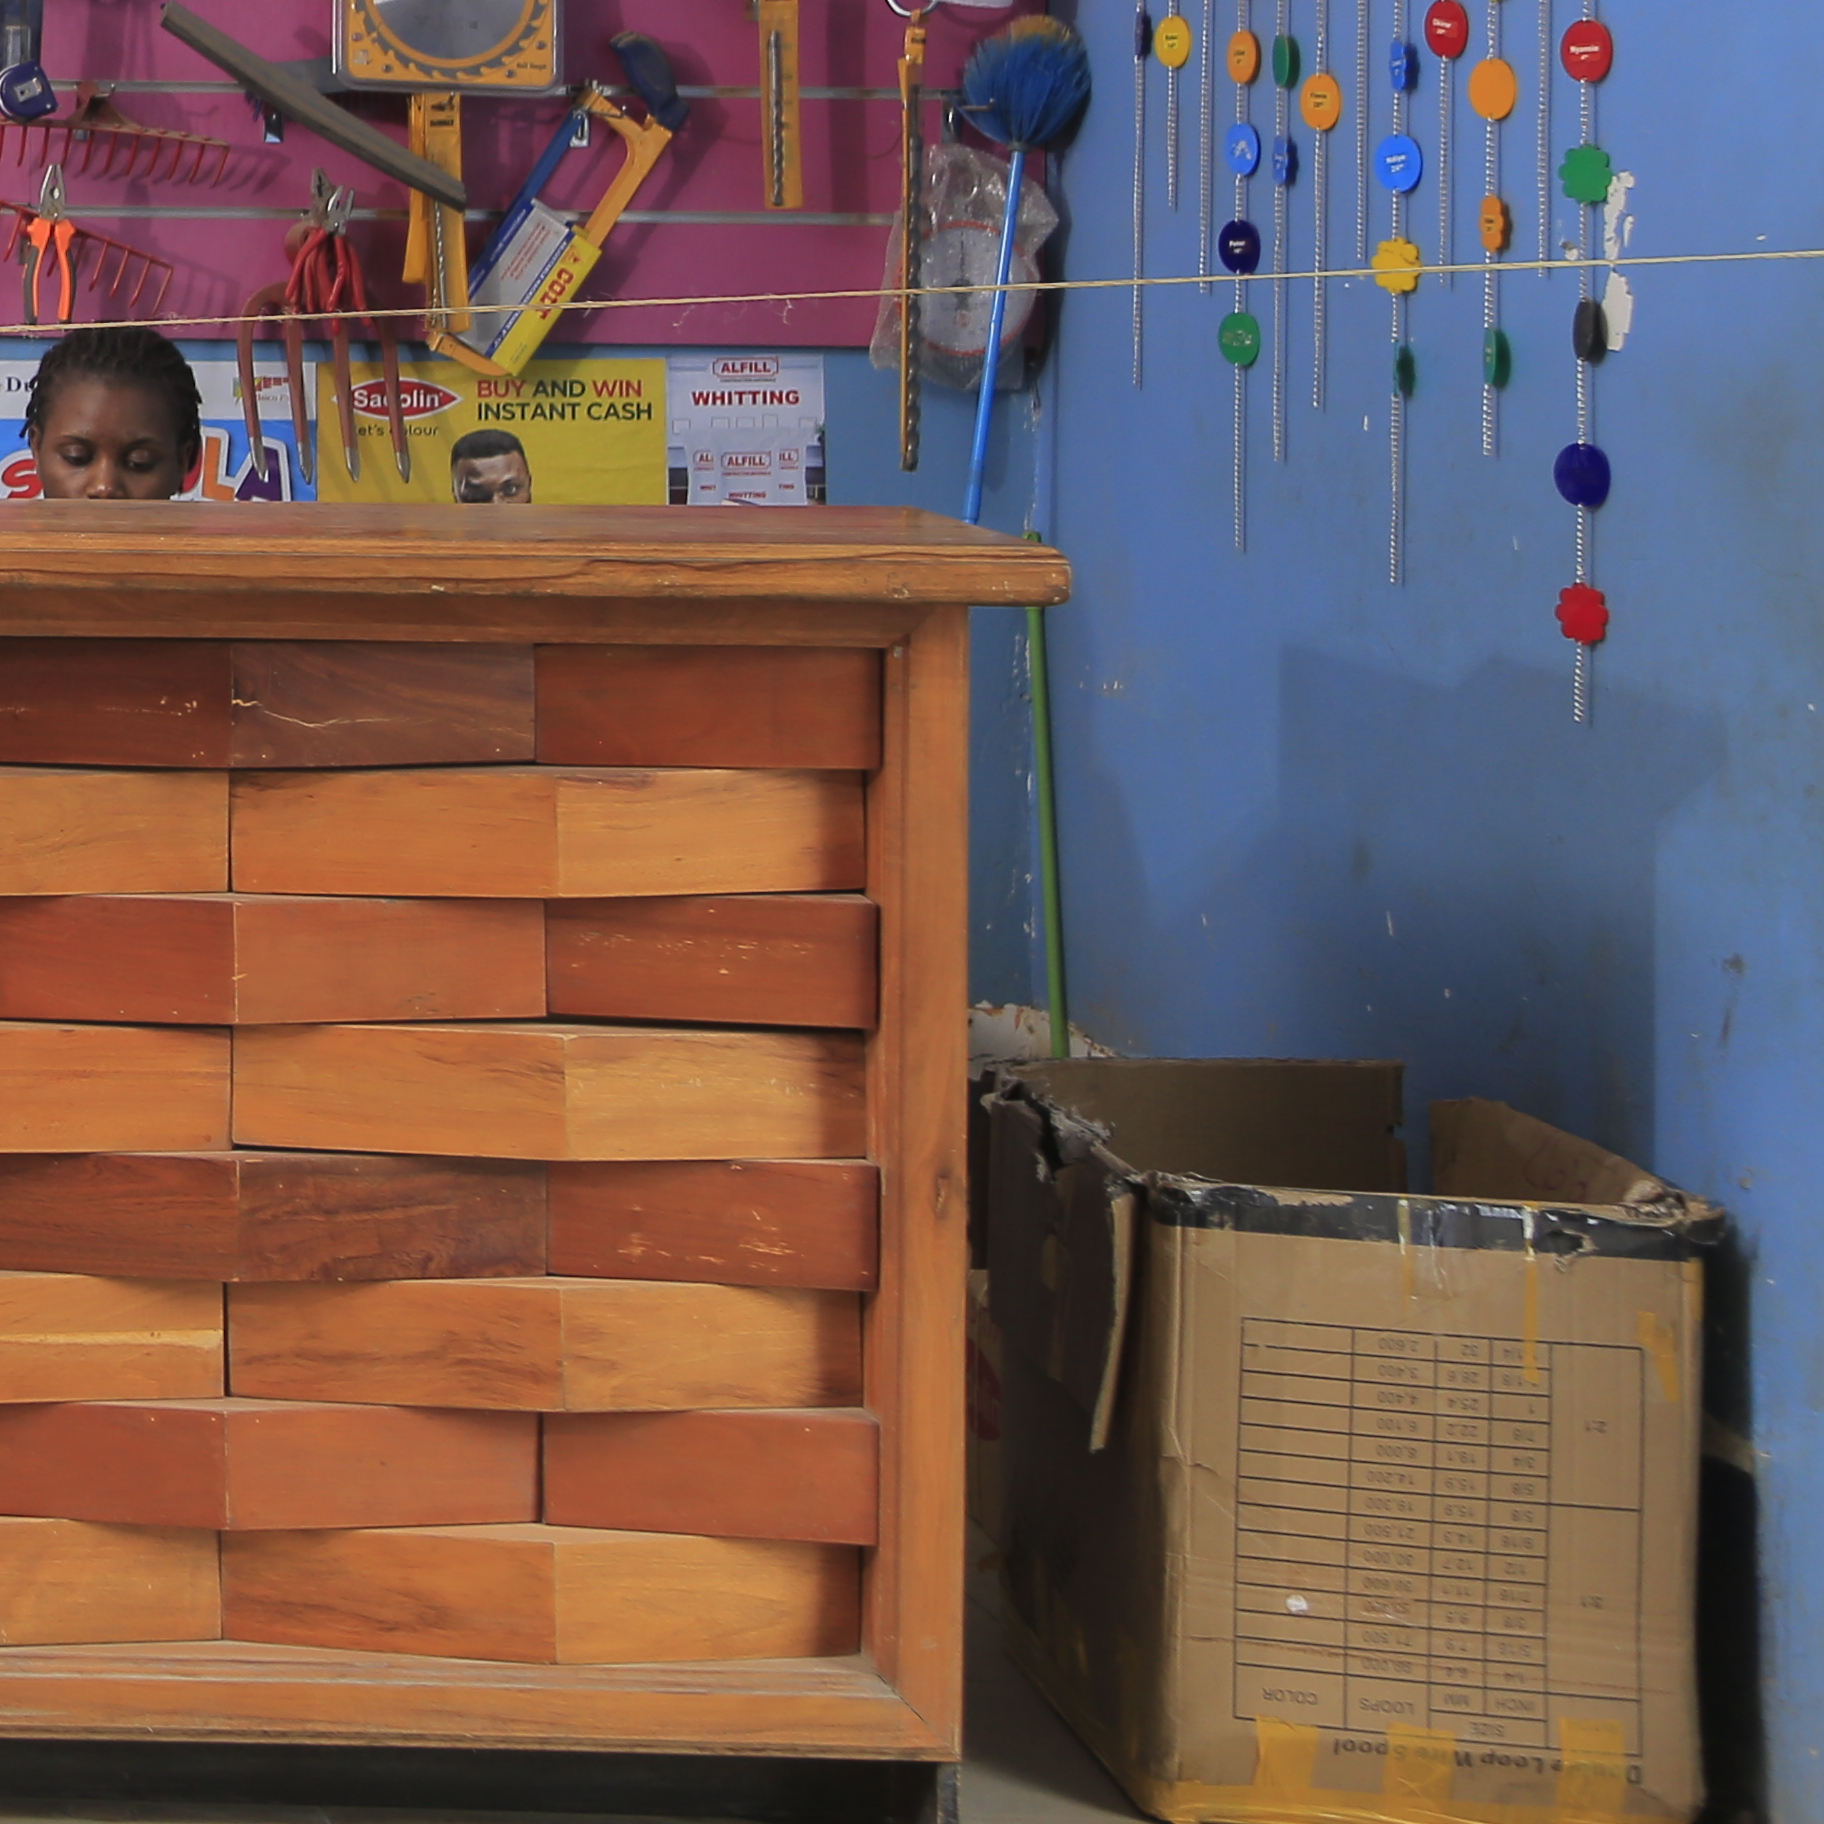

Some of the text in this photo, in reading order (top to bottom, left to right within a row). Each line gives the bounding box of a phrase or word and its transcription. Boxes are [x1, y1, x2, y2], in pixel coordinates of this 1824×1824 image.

[721, 362, 771, 373] ALFILL
[477, 380, 642, 398] BUY AND WIN
[692, 390, 799, 406] WHITTING
[477, 402, 653, 421] INSTANT CASH
[727, 456, 765, 466] ALFILL
[1261, 1687, 1318, 1706] COLOR
[1359, 1697, 1414, 1715] LOOPS
[1480, 1750, 1543, 1775] Loop
